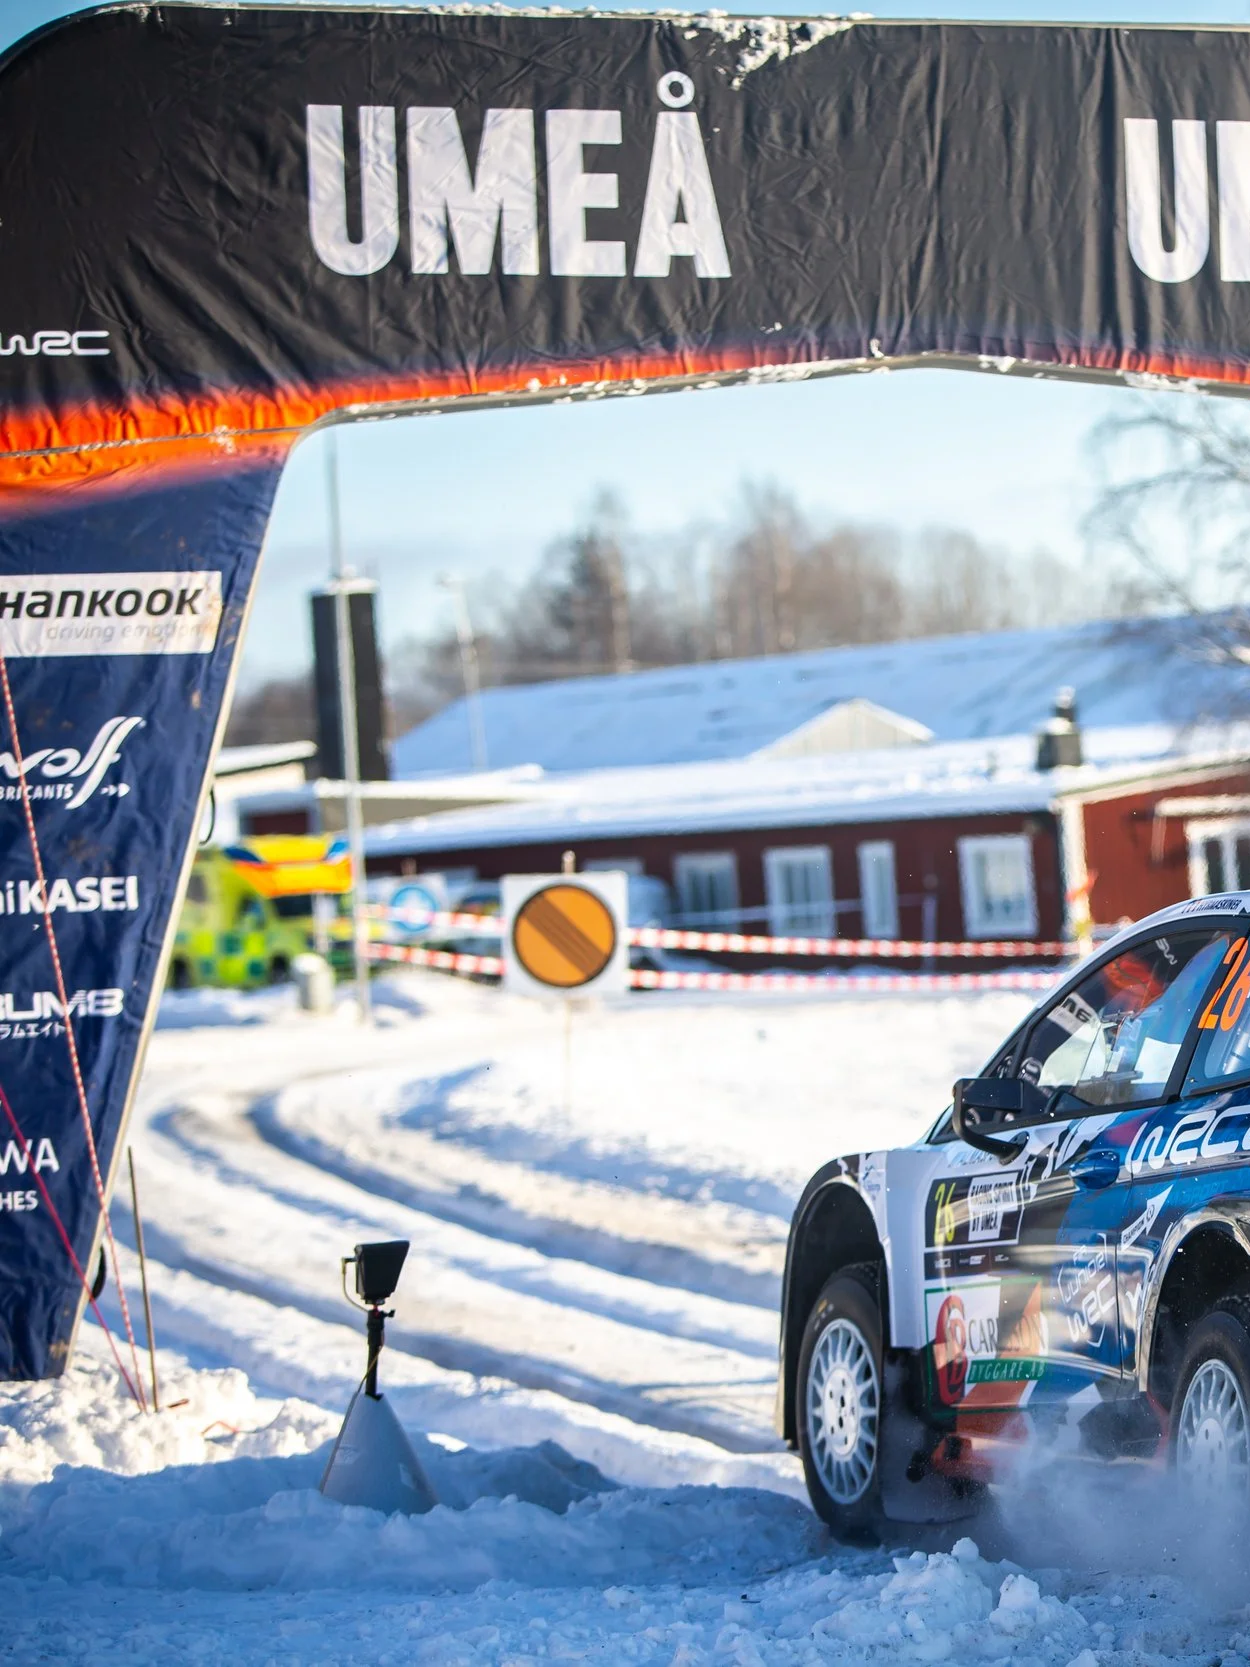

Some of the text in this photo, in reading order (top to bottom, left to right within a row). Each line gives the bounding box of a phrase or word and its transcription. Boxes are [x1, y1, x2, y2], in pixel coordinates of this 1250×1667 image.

[306, 70, 732, 278] UMEÅ
[0, 330, 110, 356] WRC
[46, 622, 116, 643] driving
[934, 1183, 956, 1246] 26
